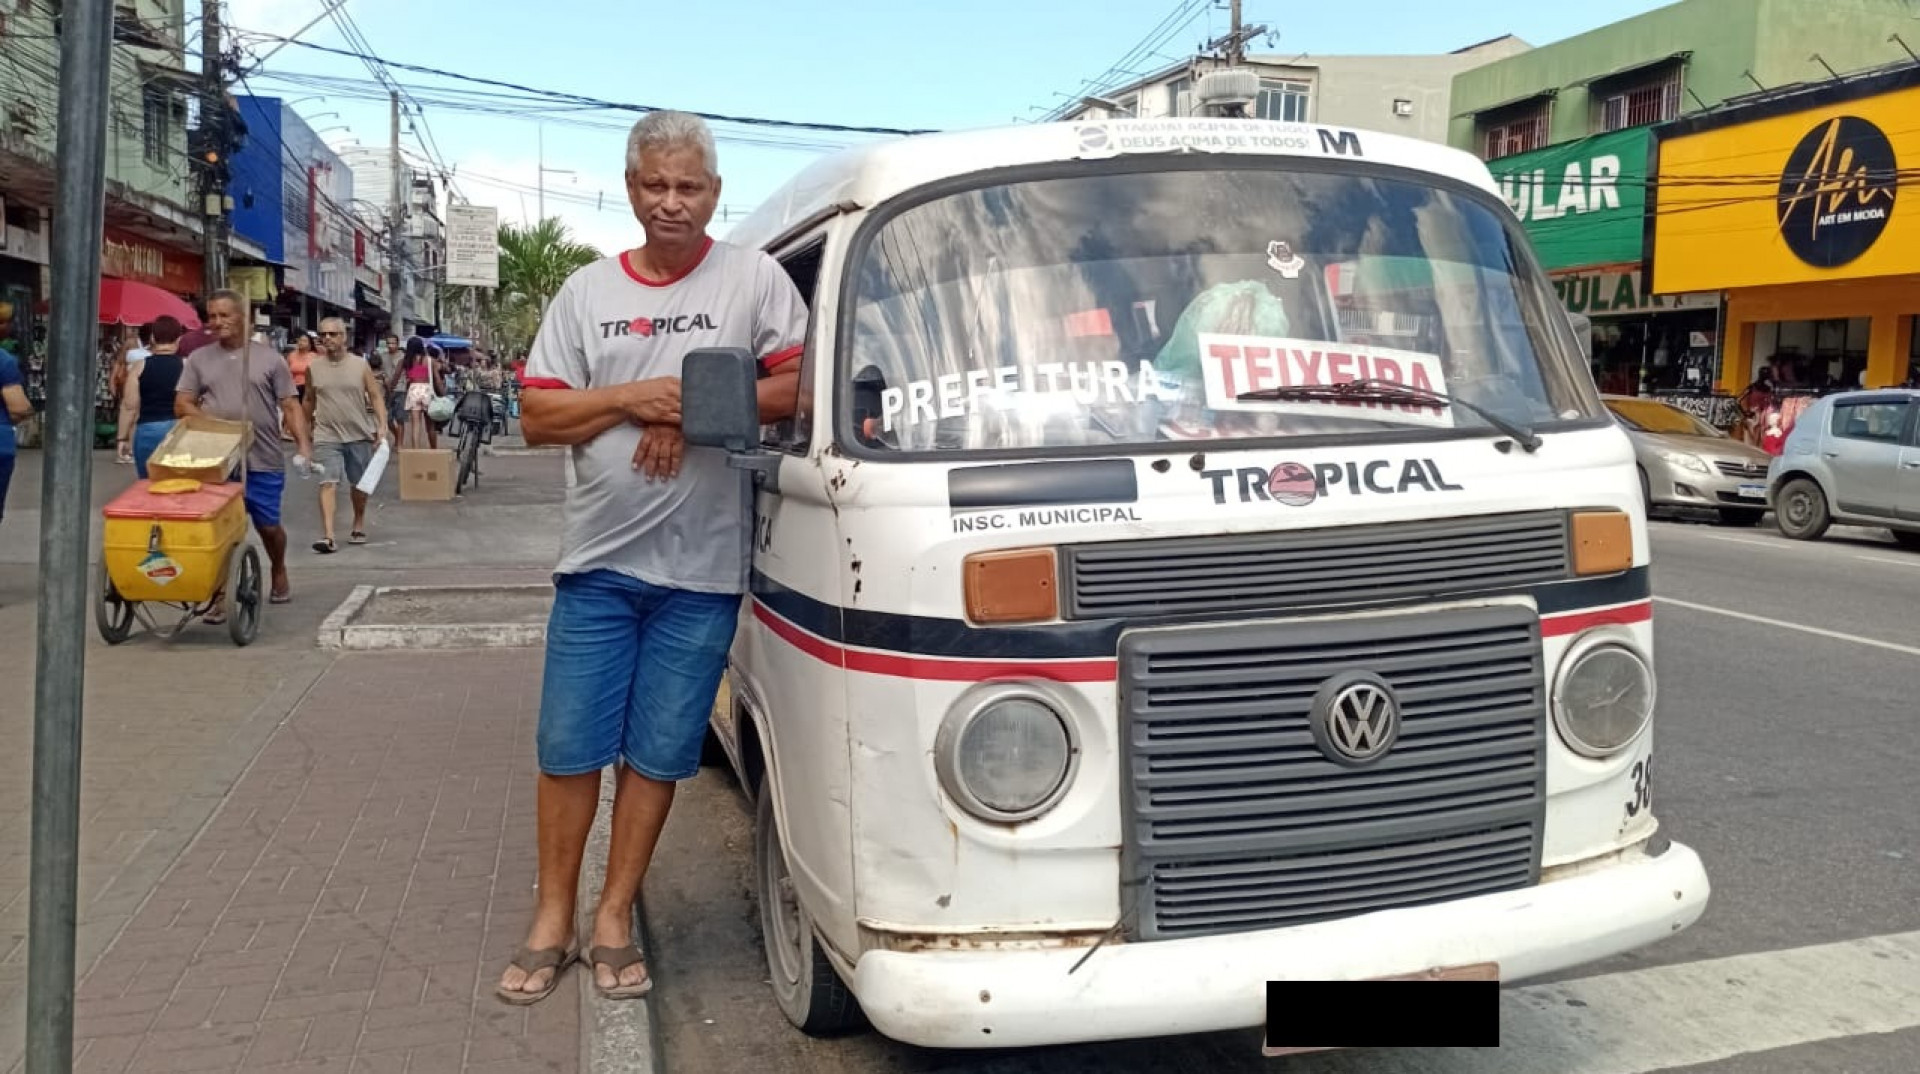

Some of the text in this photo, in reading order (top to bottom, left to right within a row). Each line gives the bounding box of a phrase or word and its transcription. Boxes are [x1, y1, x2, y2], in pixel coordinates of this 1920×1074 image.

[1120, 135, 1165, 148] DEUS
[1169, 133, 1223, 147] ACIMA
[1226, 135, 1247, 147] DE
[1316, 128, 1363, 156] M
[1818, 208, 1885, 226] ART EM MODA
[1552, 274, 1664, 313] ULA
[600, 313, 719, 340] TROPICAL
[1208, 343, 1444, 418] TEIXEIRA
[880, 358, 1168, 432] PREFEITURA
[1200, 457, 1465, 507] TROPICAL
[953, 506, 1143, 533] INSC. MUNICIPAL
